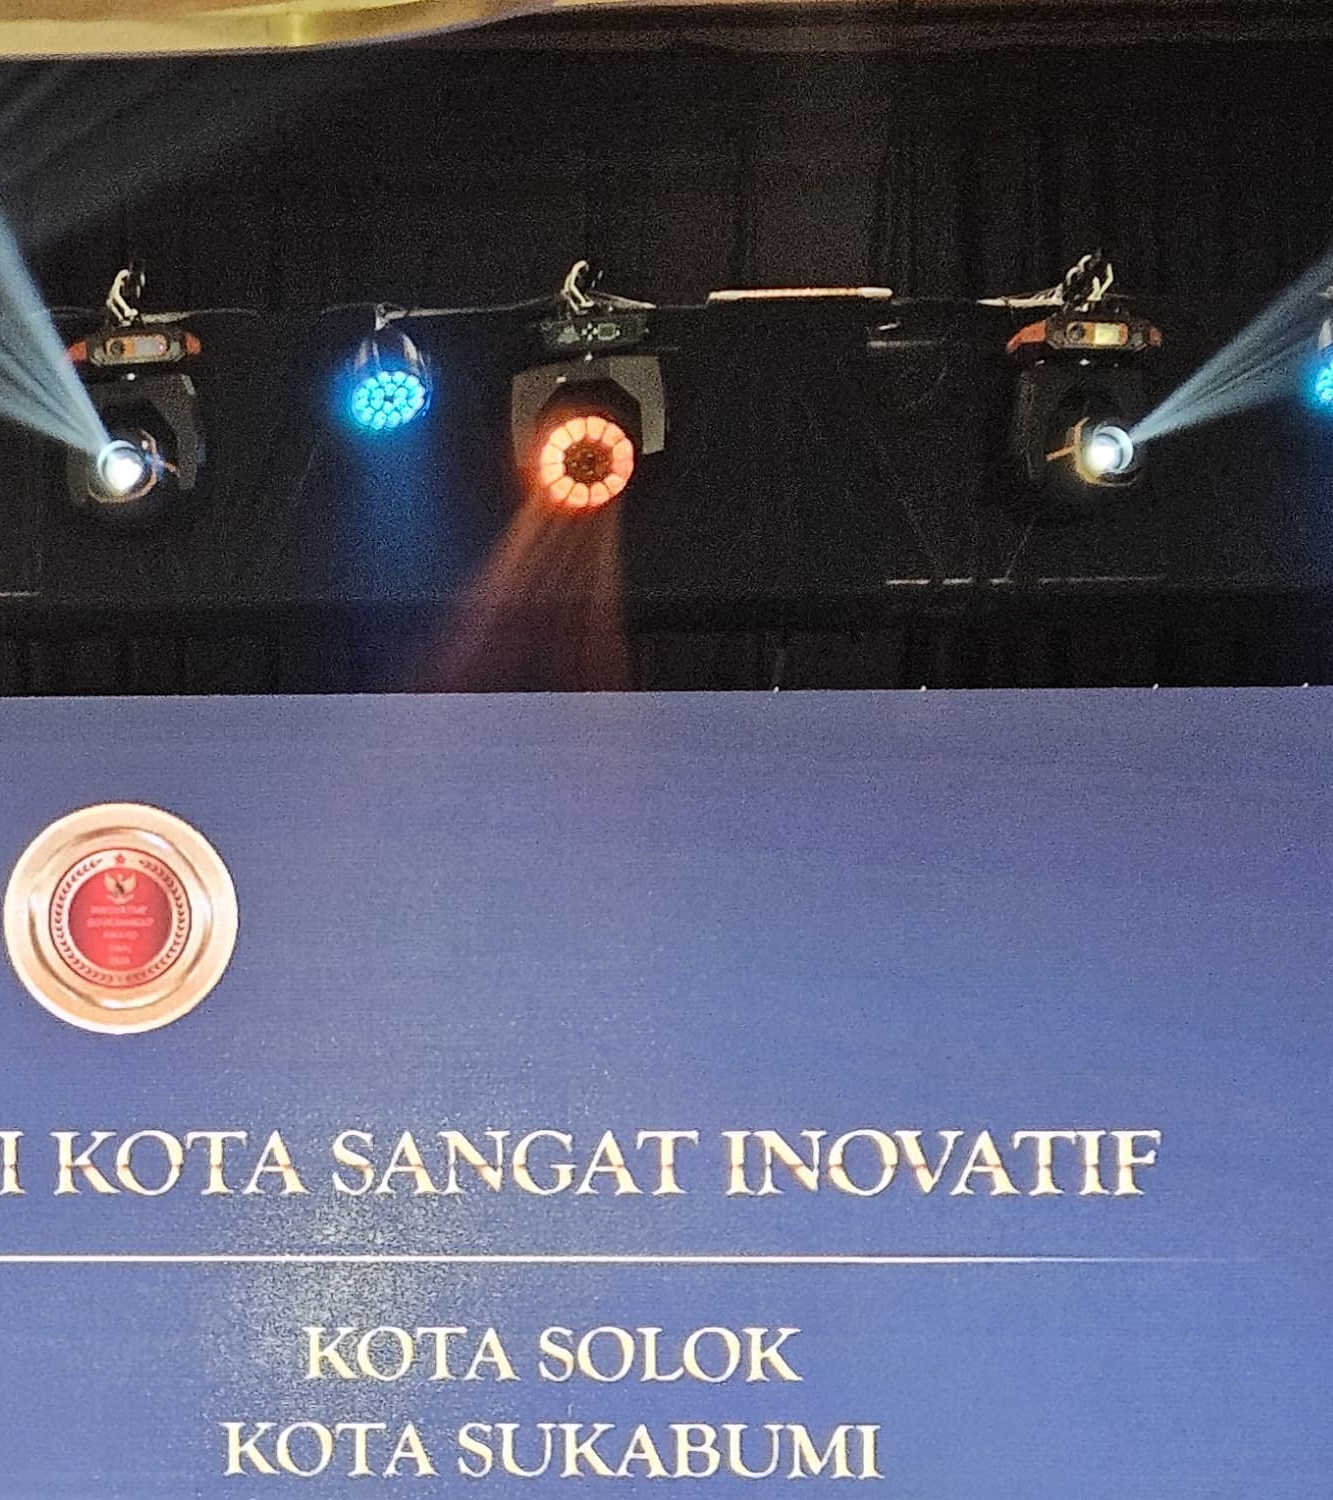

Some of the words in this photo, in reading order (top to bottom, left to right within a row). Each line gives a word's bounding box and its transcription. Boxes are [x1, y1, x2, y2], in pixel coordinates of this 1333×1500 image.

[52, 1130, 307, 1197] KOTA
[331, 1129, 700, 1197] SANGAT
[722, 1129, 1162, 1197] INOVATIF
[302, 1324, 517, 1383] KOTA
[538, 1326, 802, 1383] SOLOK
[222, 1421, 437, 1478] KOTA
[457, 1422, 880, 1480] SUKABUMI
